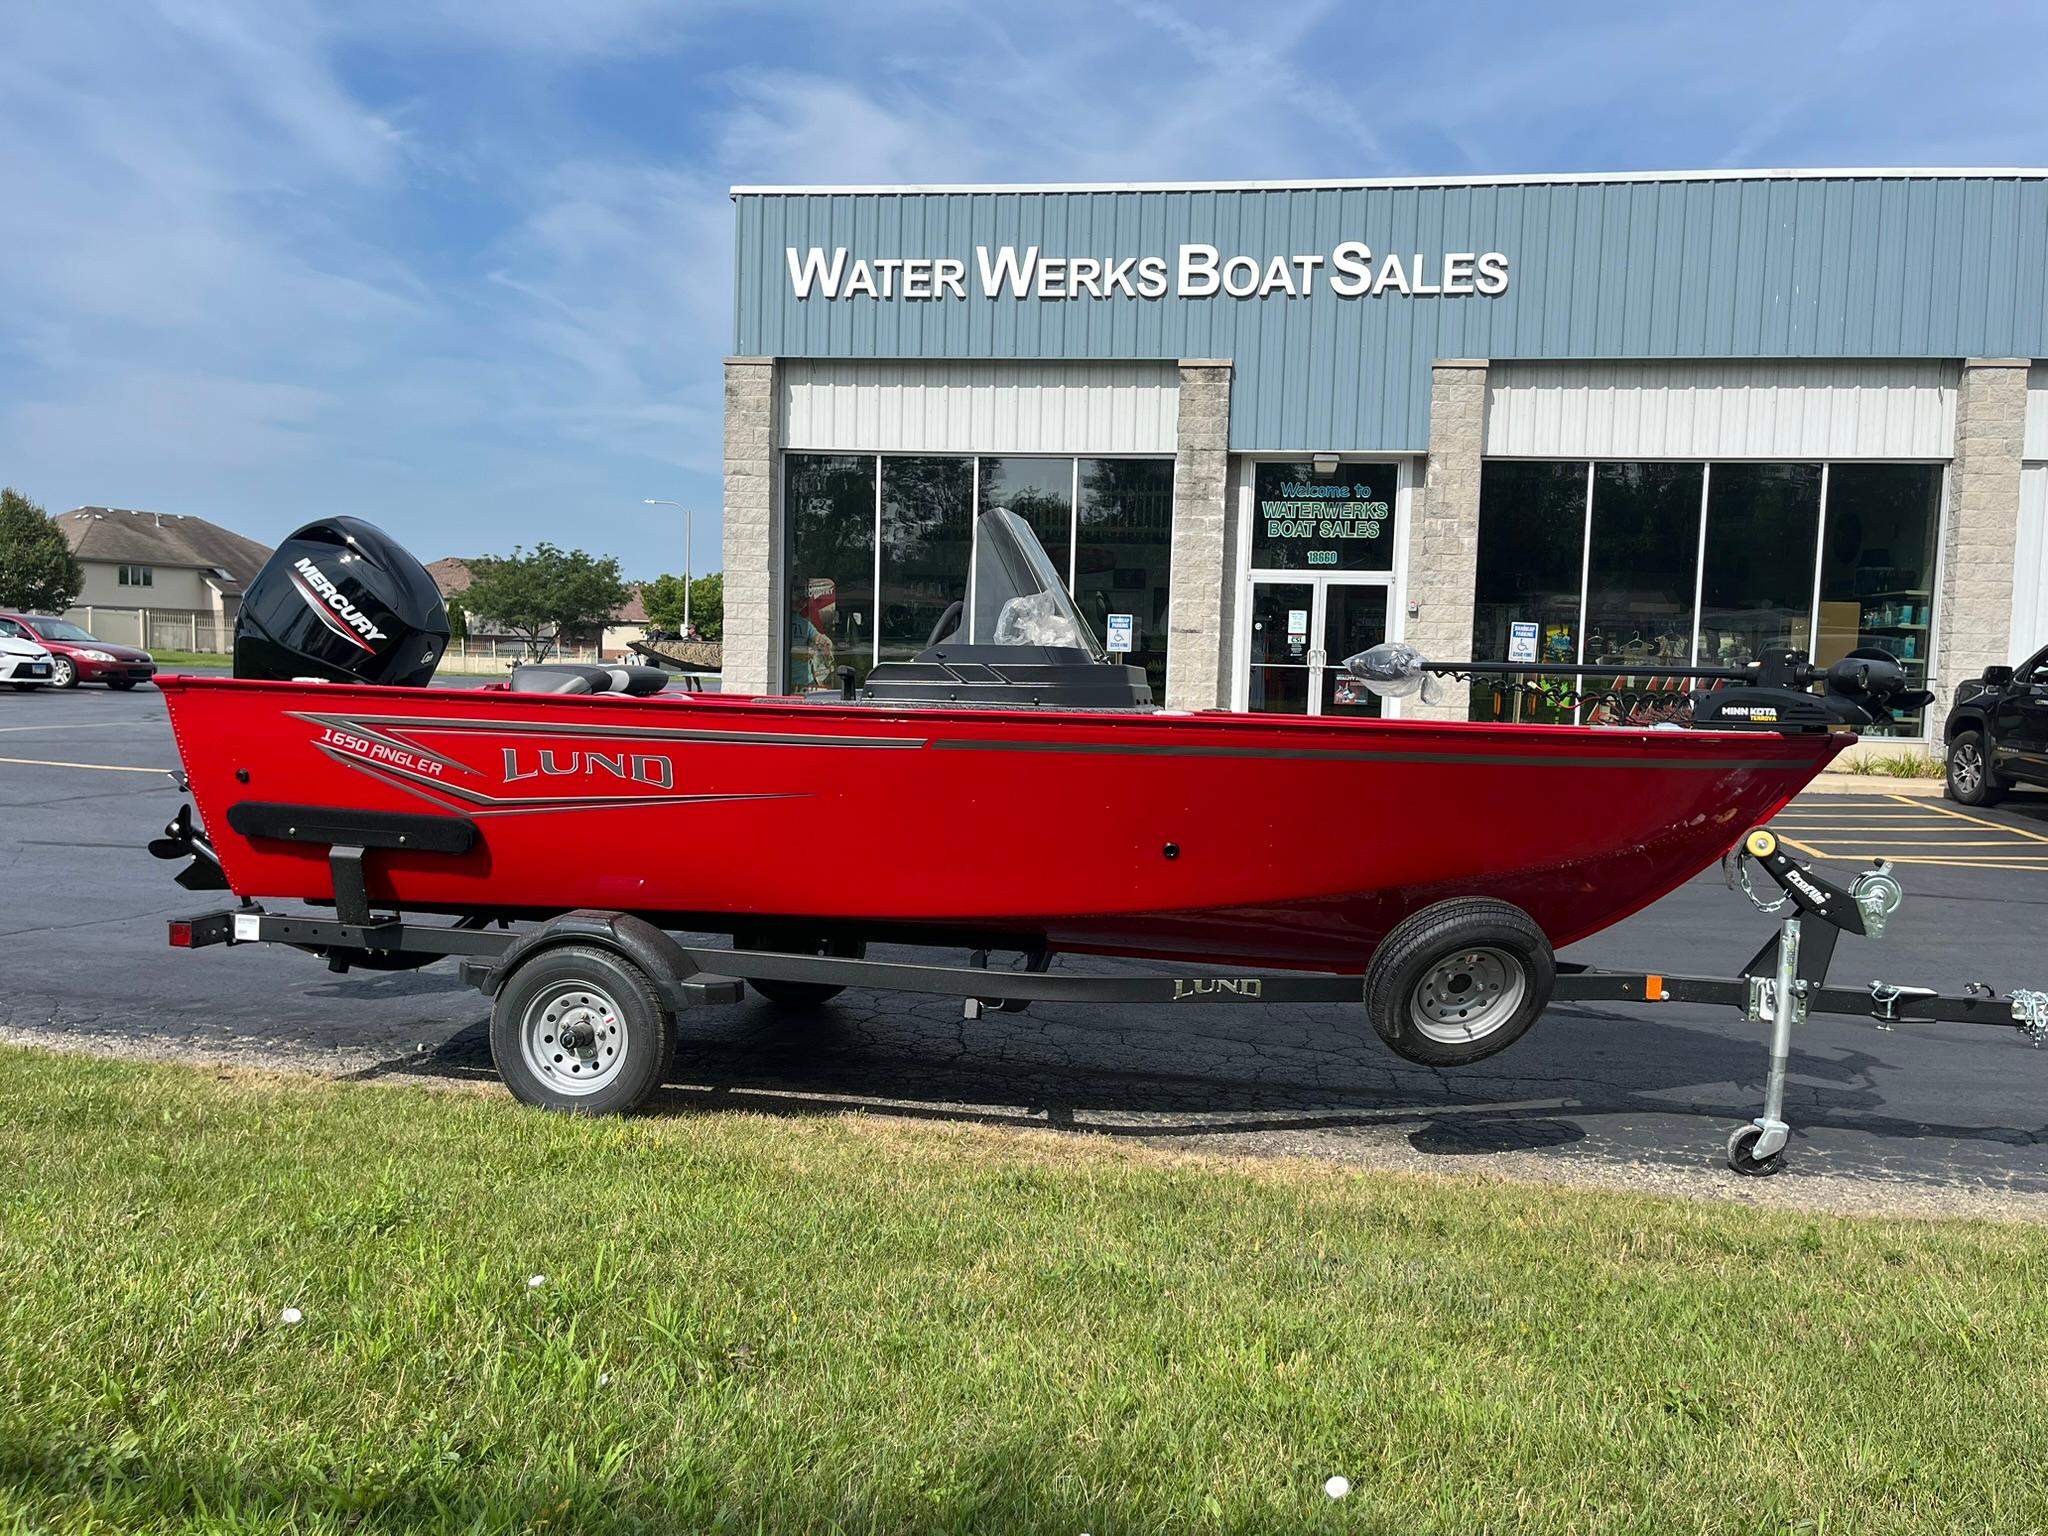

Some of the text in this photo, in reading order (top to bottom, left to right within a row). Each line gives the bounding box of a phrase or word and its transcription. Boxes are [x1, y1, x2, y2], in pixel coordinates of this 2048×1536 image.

[786, 241, 1510, 300] WATER WERKS BOAT SALES
[1280, 481, 1371, 498] Welcome to
[1261, 501, 1389, 519] WATERWERKS
[1267, 520, 1380, 539] BOAT SALES
[1307, 551, 1338, 564] 18660
[294, 557, 388, 641] MERCURY
[1722, 707, 1777, 716] MINN KOTA
[320, 728, 443, 776] 1650 ANGLER
[501, 747, 674, 790] LUND
[1173, 979, 1262, 1000] LUND
